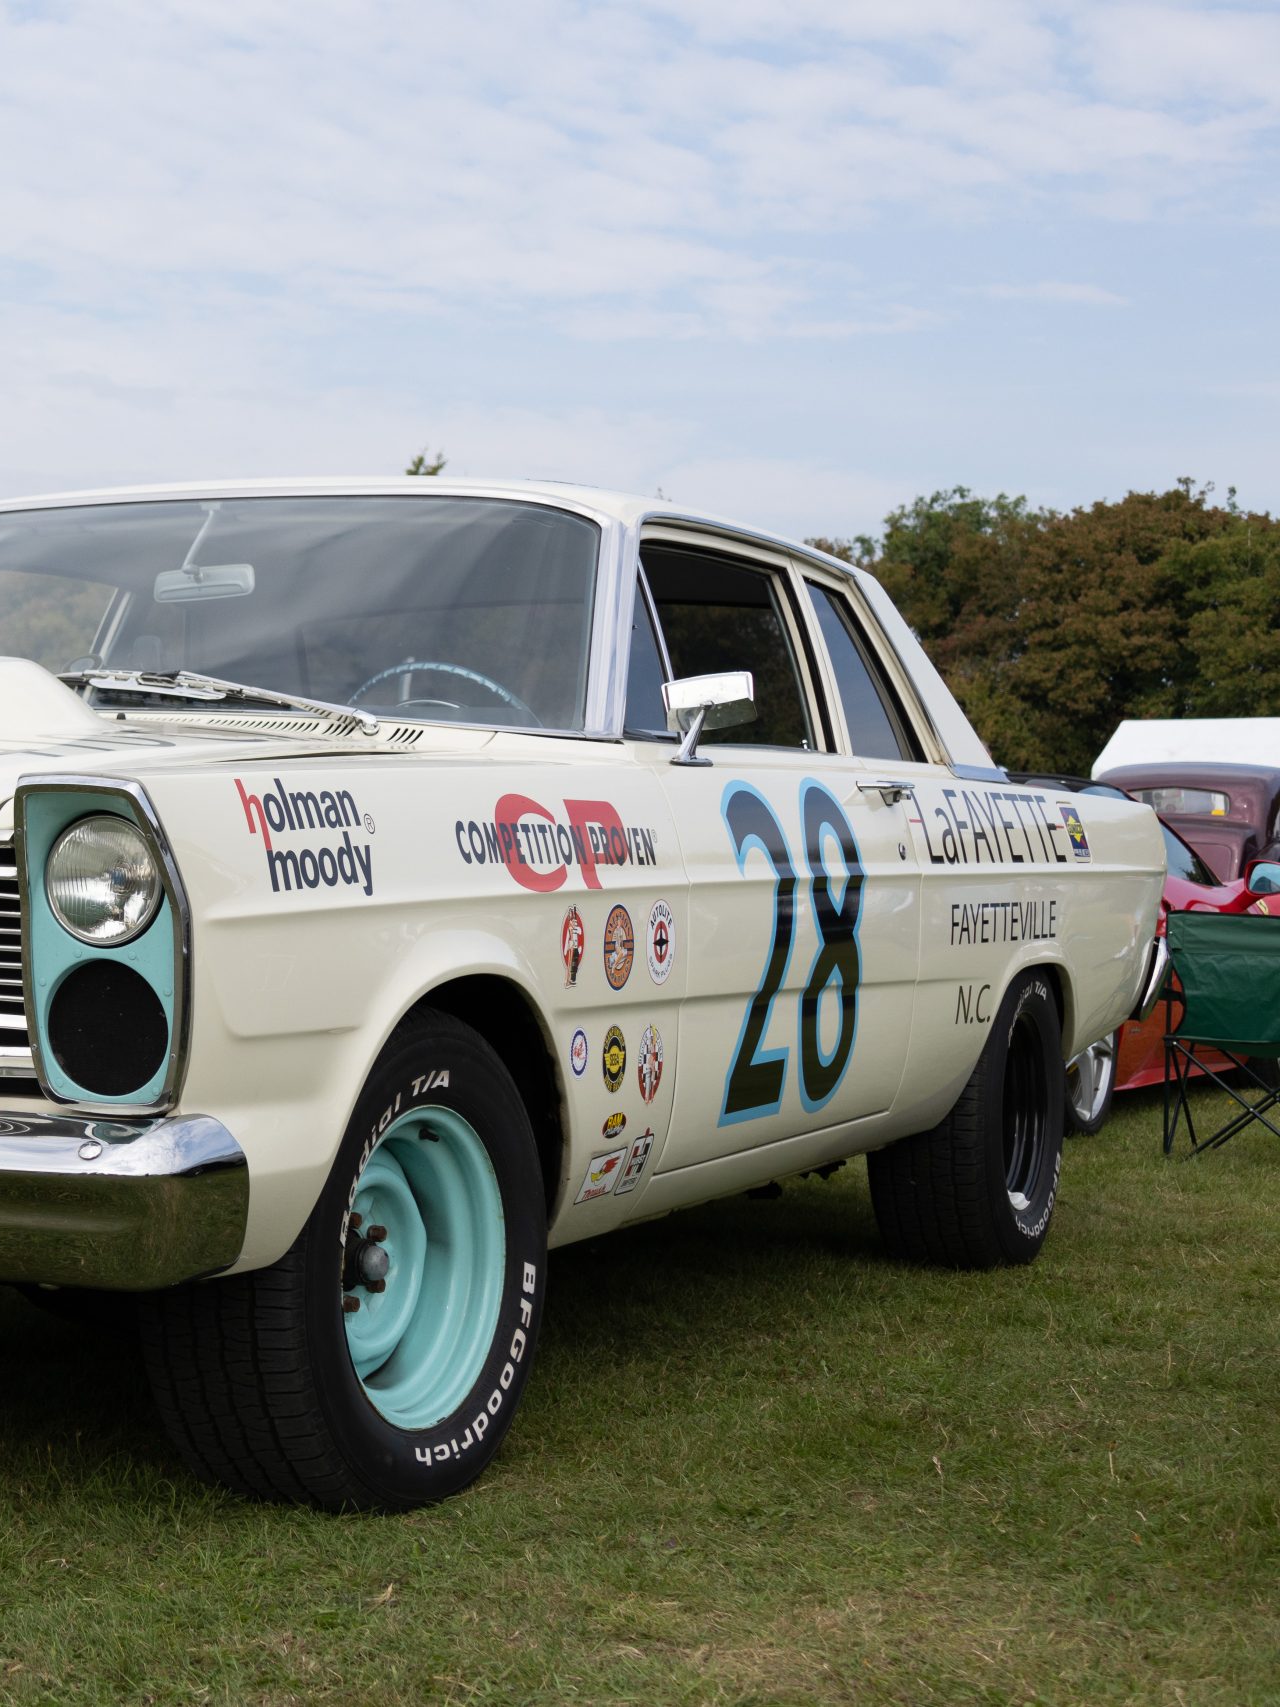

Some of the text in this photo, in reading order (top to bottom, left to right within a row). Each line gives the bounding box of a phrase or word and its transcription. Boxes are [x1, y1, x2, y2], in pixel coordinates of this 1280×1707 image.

[233, 778, 362, 850] holman
[909, 789, 1067, 864] LaFAYETTE
[267, 831, 374, 896] moody
[455, 820, 657, 866] COMPETITION PROVEN
[650, 904, 672, 930] AUTOLITE
[950, 900, 1057, 946] FAYETTEVILLE
[716, 776, 869, 1128] 28
[955, 984, 992, 1025] N.C.
[411, 1070, 450, 1097] T/A
[415, 1261, 537, 1467] BFGoodrich
